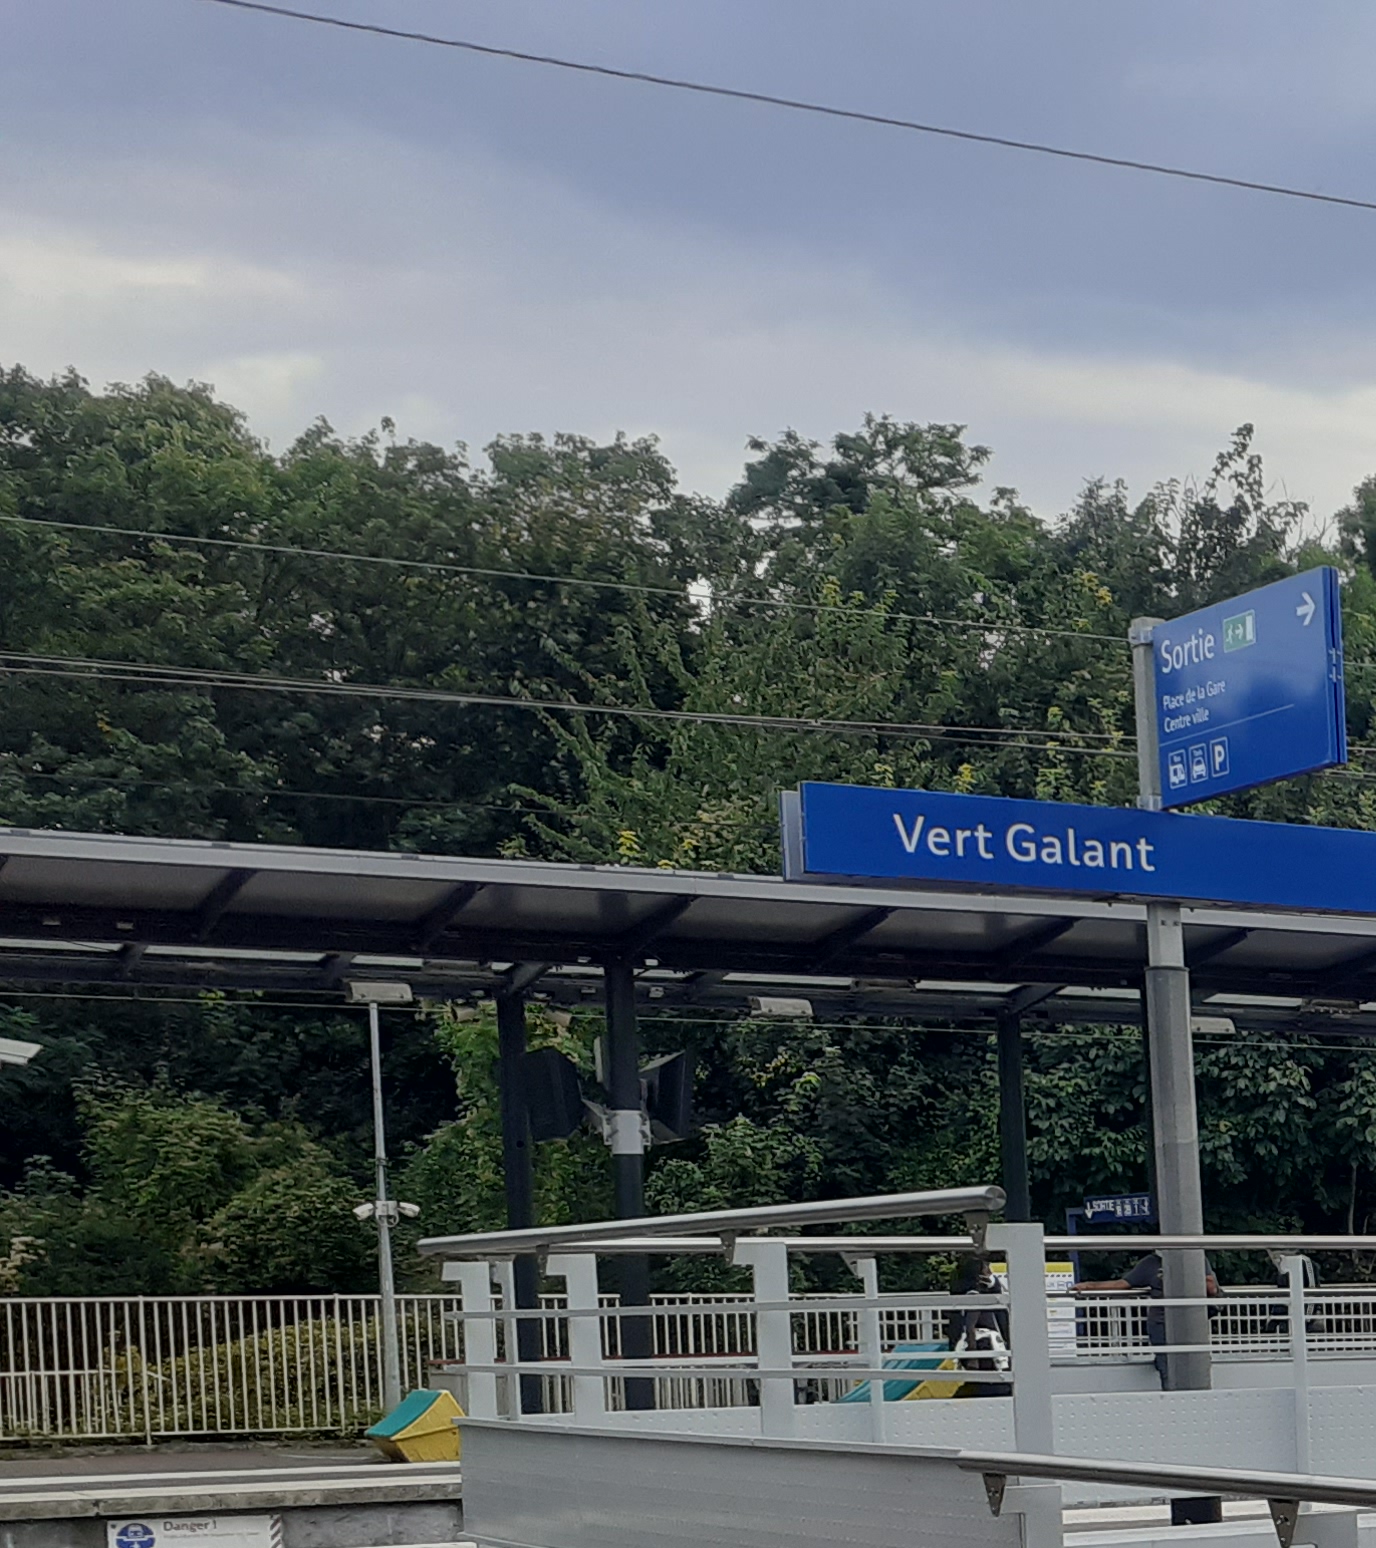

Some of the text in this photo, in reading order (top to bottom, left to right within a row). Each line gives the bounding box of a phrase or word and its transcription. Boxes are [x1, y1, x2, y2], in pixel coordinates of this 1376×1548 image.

[1161, 628, 1216, 674] Sortie
[1162, 678, 1226, 711] Place de la Gare
[1164, 707, 1210, 733] Centre ville
[893, 814, 1156, 872] Vert Galant
[163, 1521, 209, 1533] Danger
